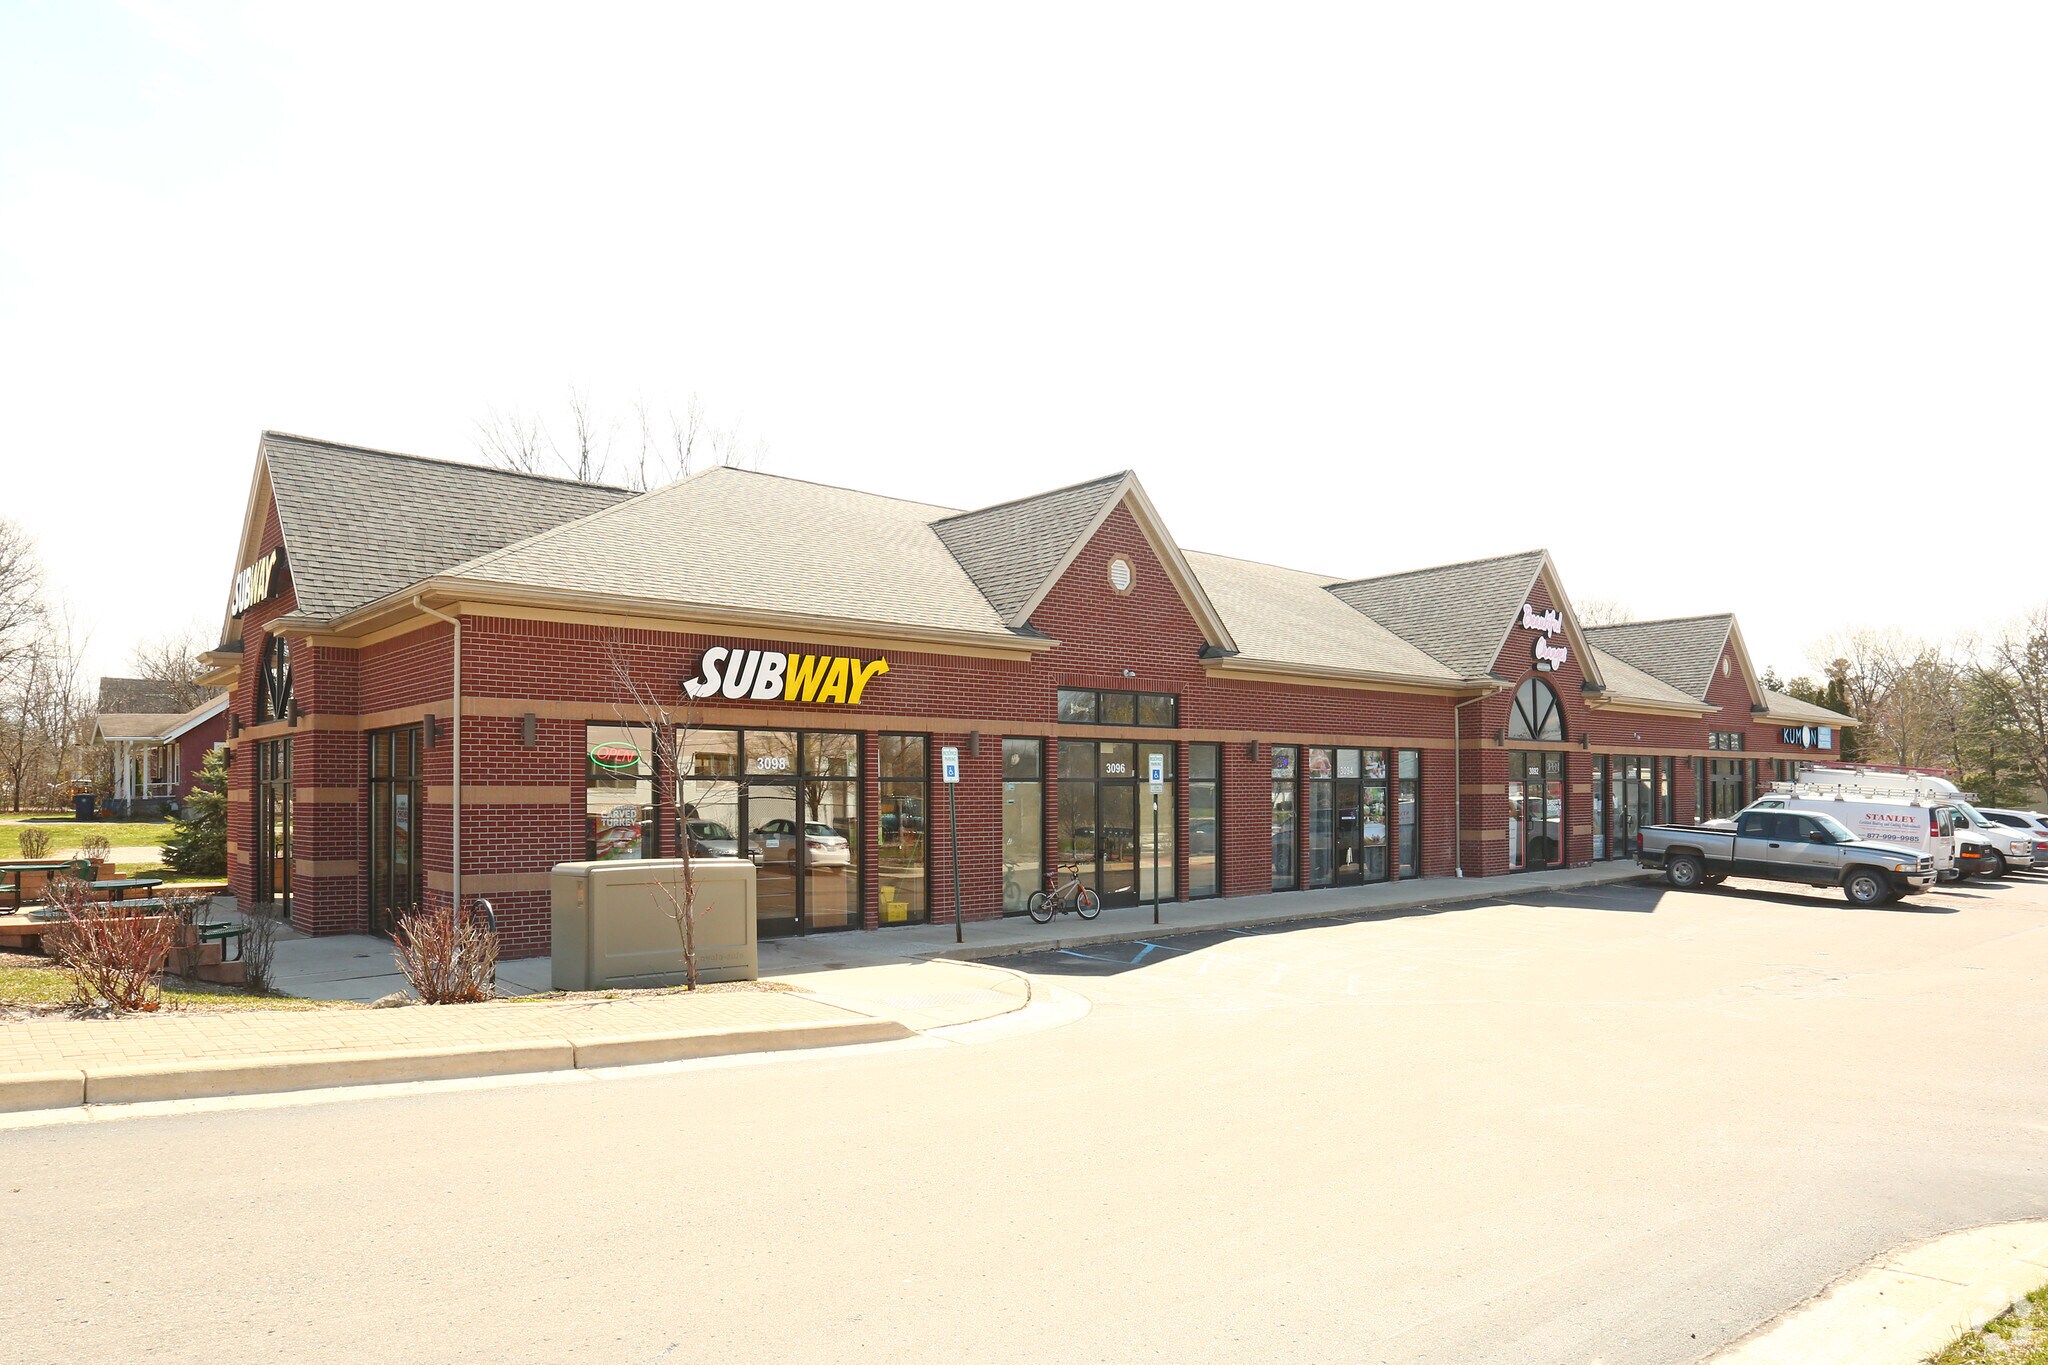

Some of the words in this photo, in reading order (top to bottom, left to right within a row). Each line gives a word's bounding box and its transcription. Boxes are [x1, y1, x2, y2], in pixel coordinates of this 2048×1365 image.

[232, 548, 277, 616] SUBWAY
[683, 646, 890, 705] SUBWAY
[1783, 725, 1817, 749] KUMON
[597, 746, 634, 763] OPEN
[757, 757, 786, 770] 3098
[1106, 763, 1126, 774] 3096
[1340, 766, 1354, 776] 3094
[1528, 767, 1539, 775] 3092
[601, 809, 637, 819] CARVED
[1865, 813, 1916, 823] STANLEY
[601, 818, 637, 827] TURKEY
[1866, 833, 1919, 842] 877-999-9985
